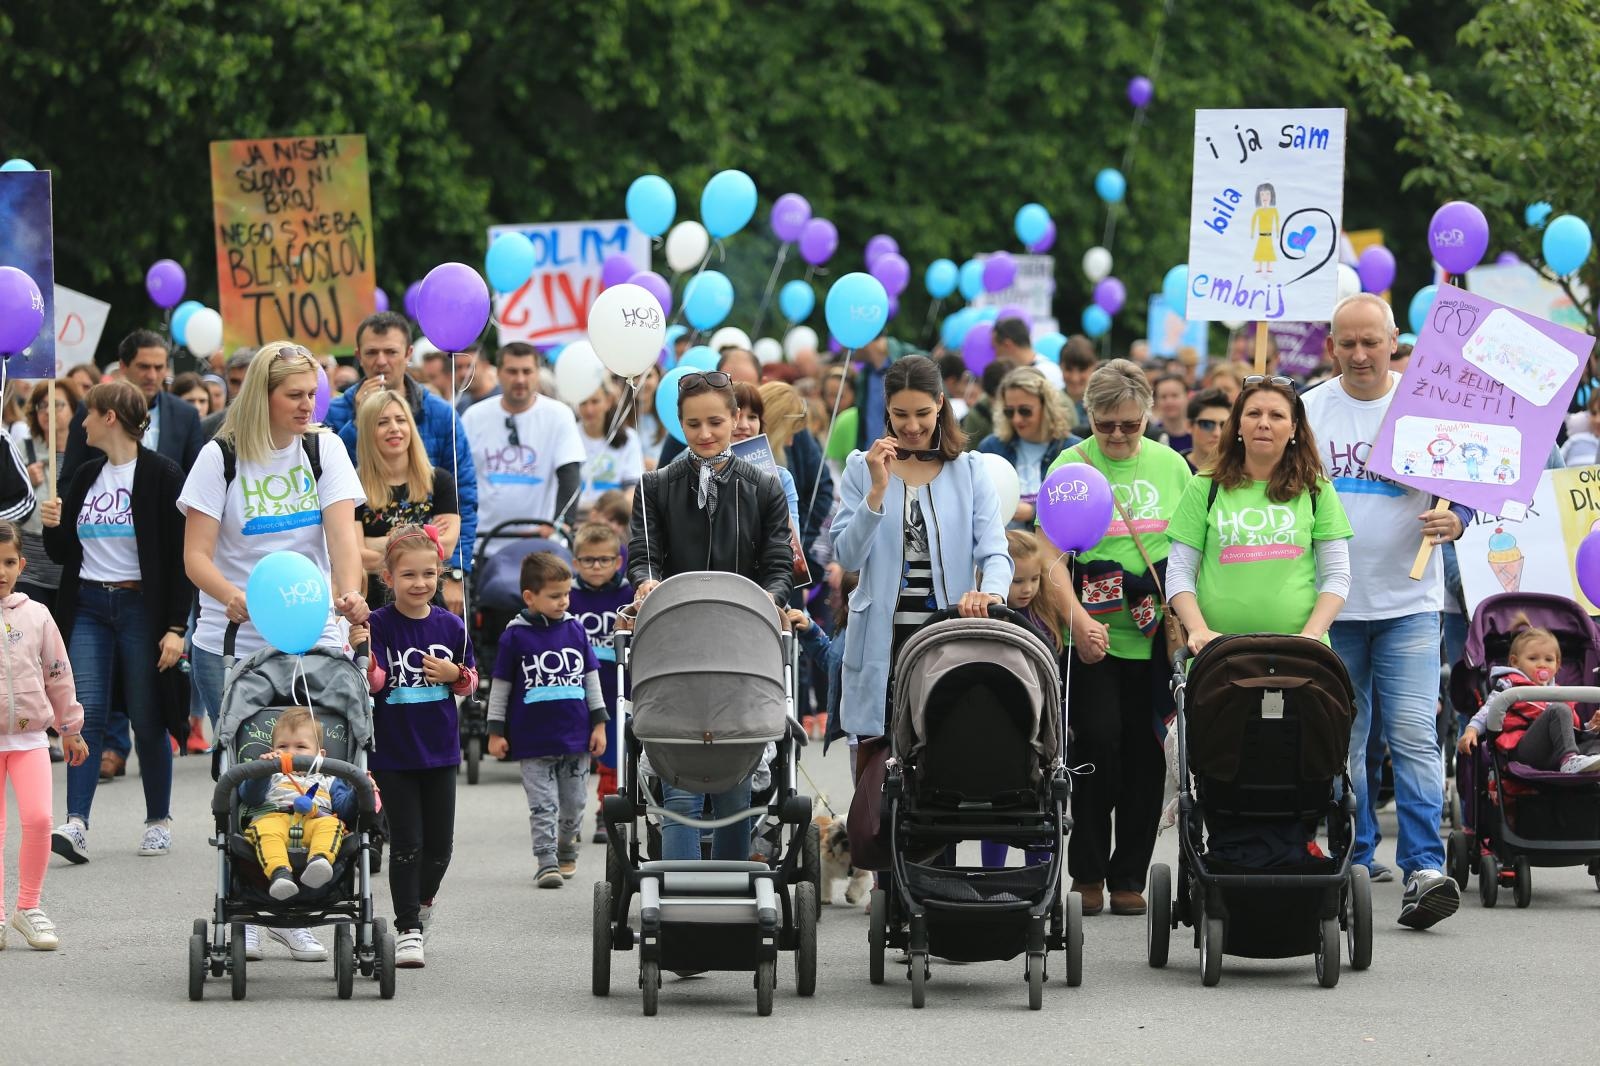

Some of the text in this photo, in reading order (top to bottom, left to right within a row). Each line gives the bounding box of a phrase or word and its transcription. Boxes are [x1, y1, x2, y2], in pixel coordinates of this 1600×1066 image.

[242, 139, 340, 168] JA NISAM
[1206, 124, 1330, 163] i ja sam
[236, 166, 332, 193] SLOVO NI
[1204, 188, 1243, 235] bila
[220, 212, 363, 247] NEGO S NEBA
[228, 234, 367, 289] BLAGOSLOV
[1192, 274, 1285, 318] embrij
[242, 286, 342, 346] TVOJ
[622, 307, 660, 322] HOD
[1431, 361, 1451, 379] JA
[1457, 367, 1505, 396] ŽELIM
[1329, 440, 1373, 468] HO
[241, 465, 316, 507] HOD
[1047, 480, 1088, 498] HOD
[1579, 469, 1600, 483] OV
[83, 488, 133, 514] HOD
[244, 494, 320, 518] ZA ŽIVOT
[1111, 479, 1160, 510] OD
[78, 512, 134, 525] ZA ŽIVOT
[1217, 504, 1296, 537] HOD
[1219, 529, 1299, 547] ZA ŽIVOT
[279, 580, 321, 601] HOD
[575, 611, 617, 637] OD
[521, 647, 584, 680] HOD
[389, 672, 408, 688] ZA
[524, 674, 585, 689] ZA ŽIVOT
